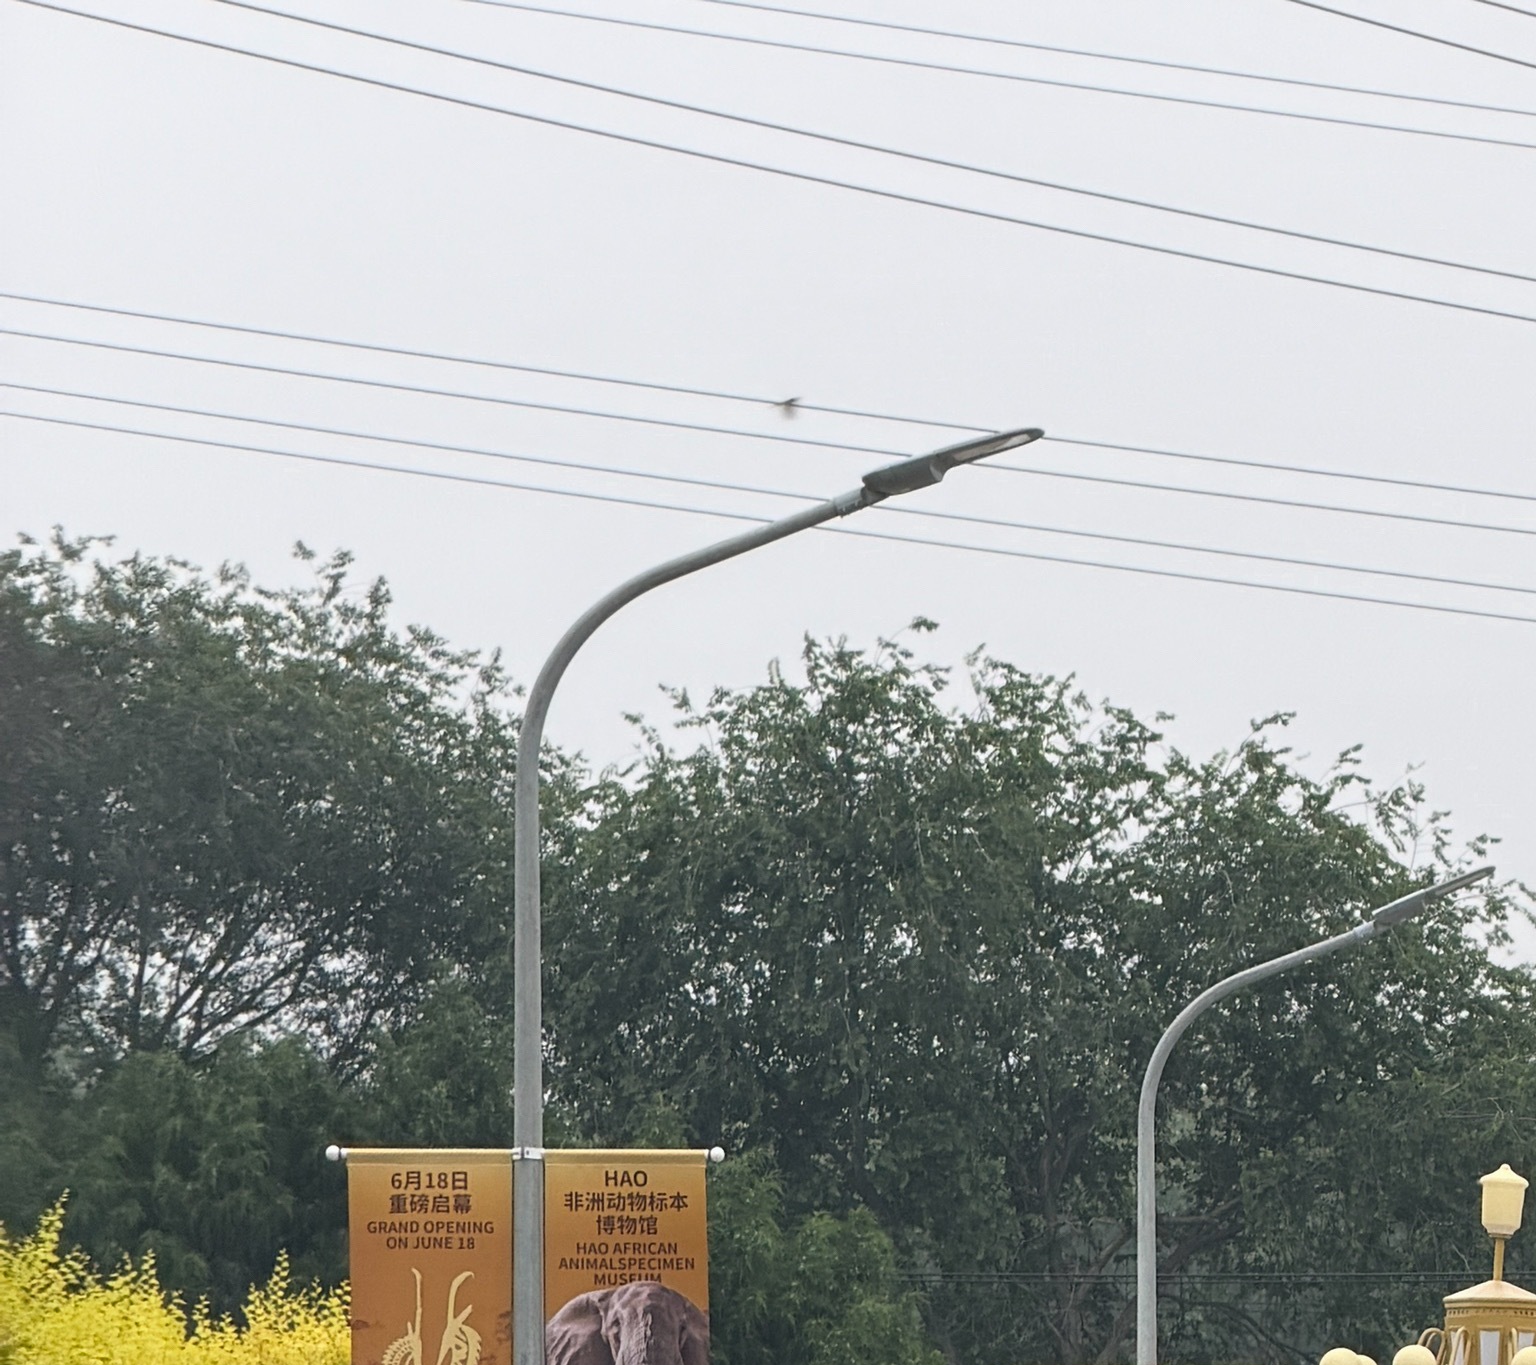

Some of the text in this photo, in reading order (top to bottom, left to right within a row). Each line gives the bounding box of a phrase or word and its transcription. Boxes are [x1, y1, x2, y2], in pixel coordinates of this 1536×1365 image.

[391, 1171, 468, 1190] 6月18日
[605, 1170, 648, 1187] HAO
[389, 1193, 472, 1214] 重磅启幕
[564, 1191, 689, 1212] 非洲动物标本
[367, 1220, 495, 1234] GRAND OPENING
[596, 1215, 658, 1235] 博物馆
[386, 1237, 475, 1250] ON JUNE 18
[576, 1242, 678, 1255] HAO AFRICAN
[558, 1257, 695, 1270] ANIMALSPECIMEN
